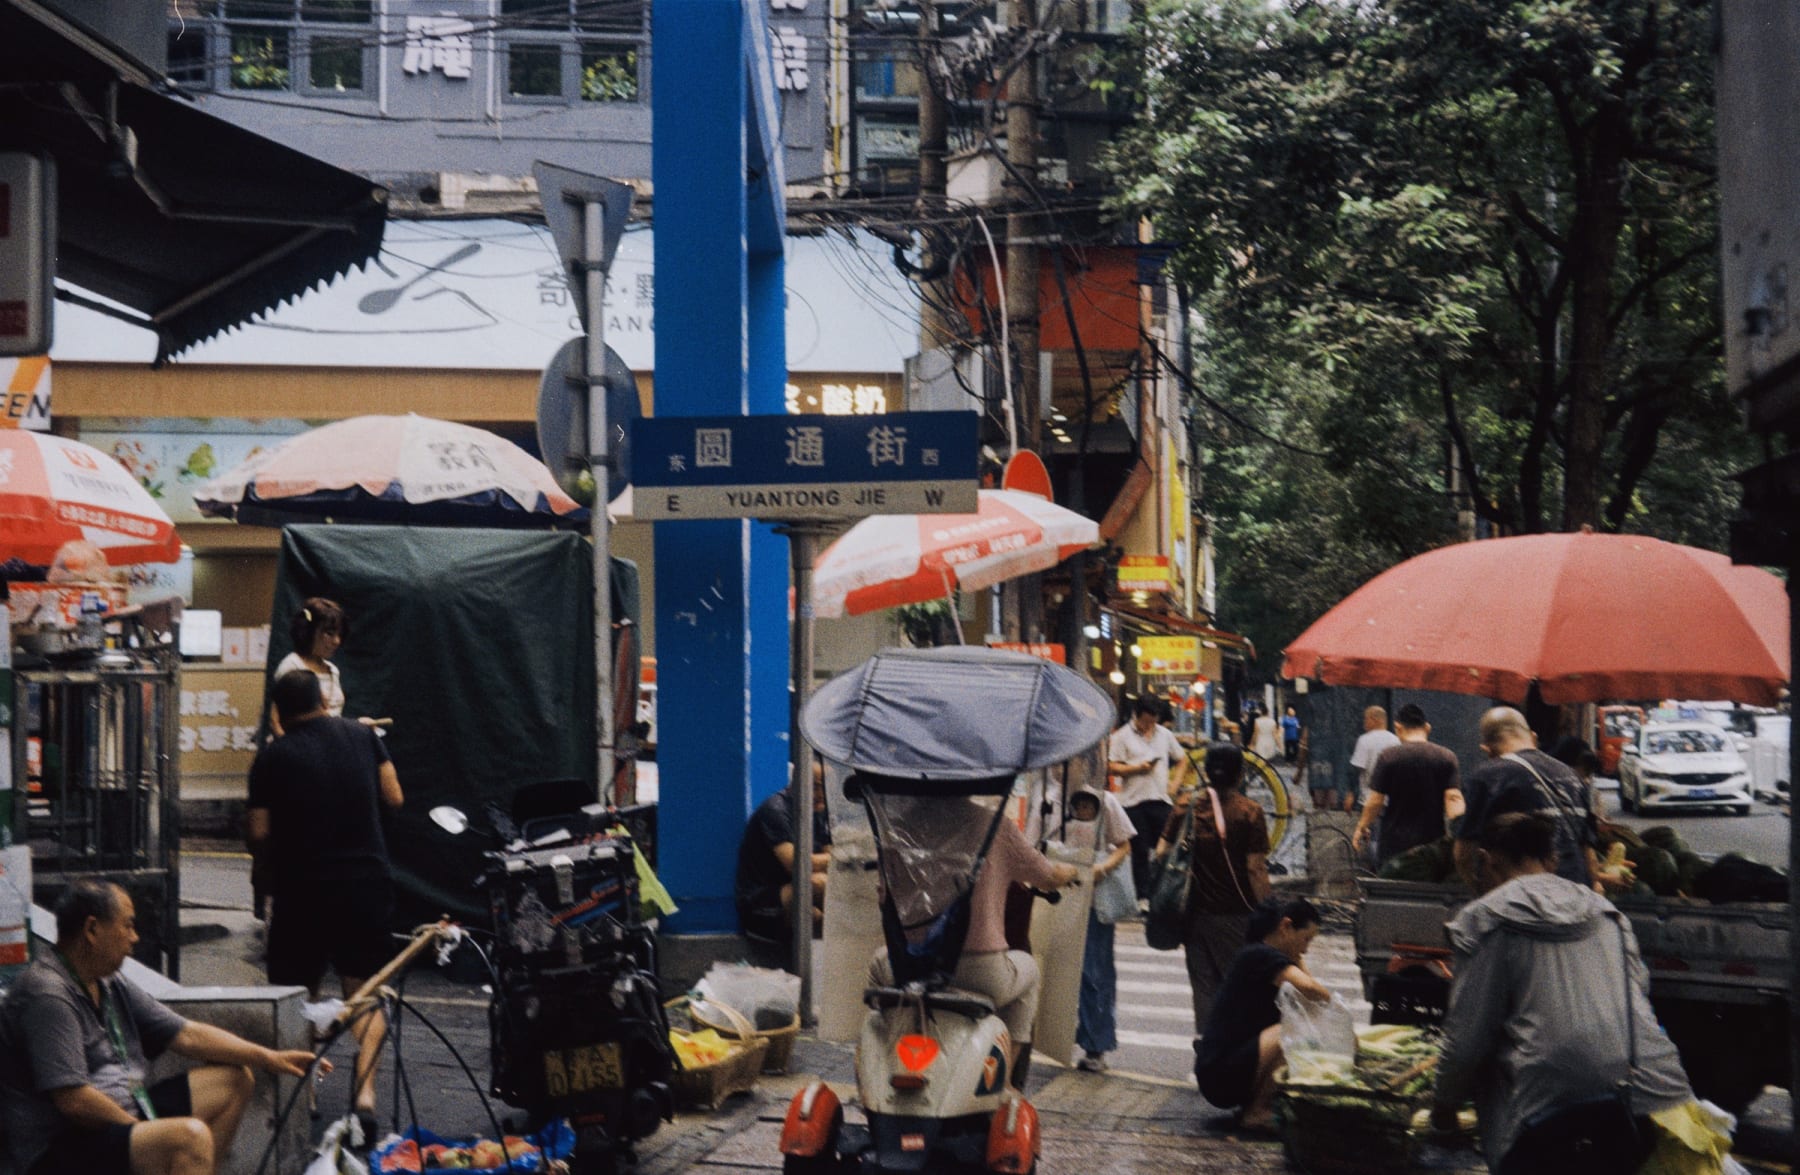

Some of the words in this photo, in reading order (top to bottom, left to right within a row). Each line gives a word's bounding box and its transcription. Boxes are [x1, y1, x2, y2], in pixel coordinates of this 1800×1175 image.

[668, 454, 686, 472] 东
[921, 448, 939, 466] 西
[667, 494, 681, 512] E
[726, 489, 840, 507] YUANTONG
[854, 489, 886, 506] JIE
[923, 488, 945, 507] W
